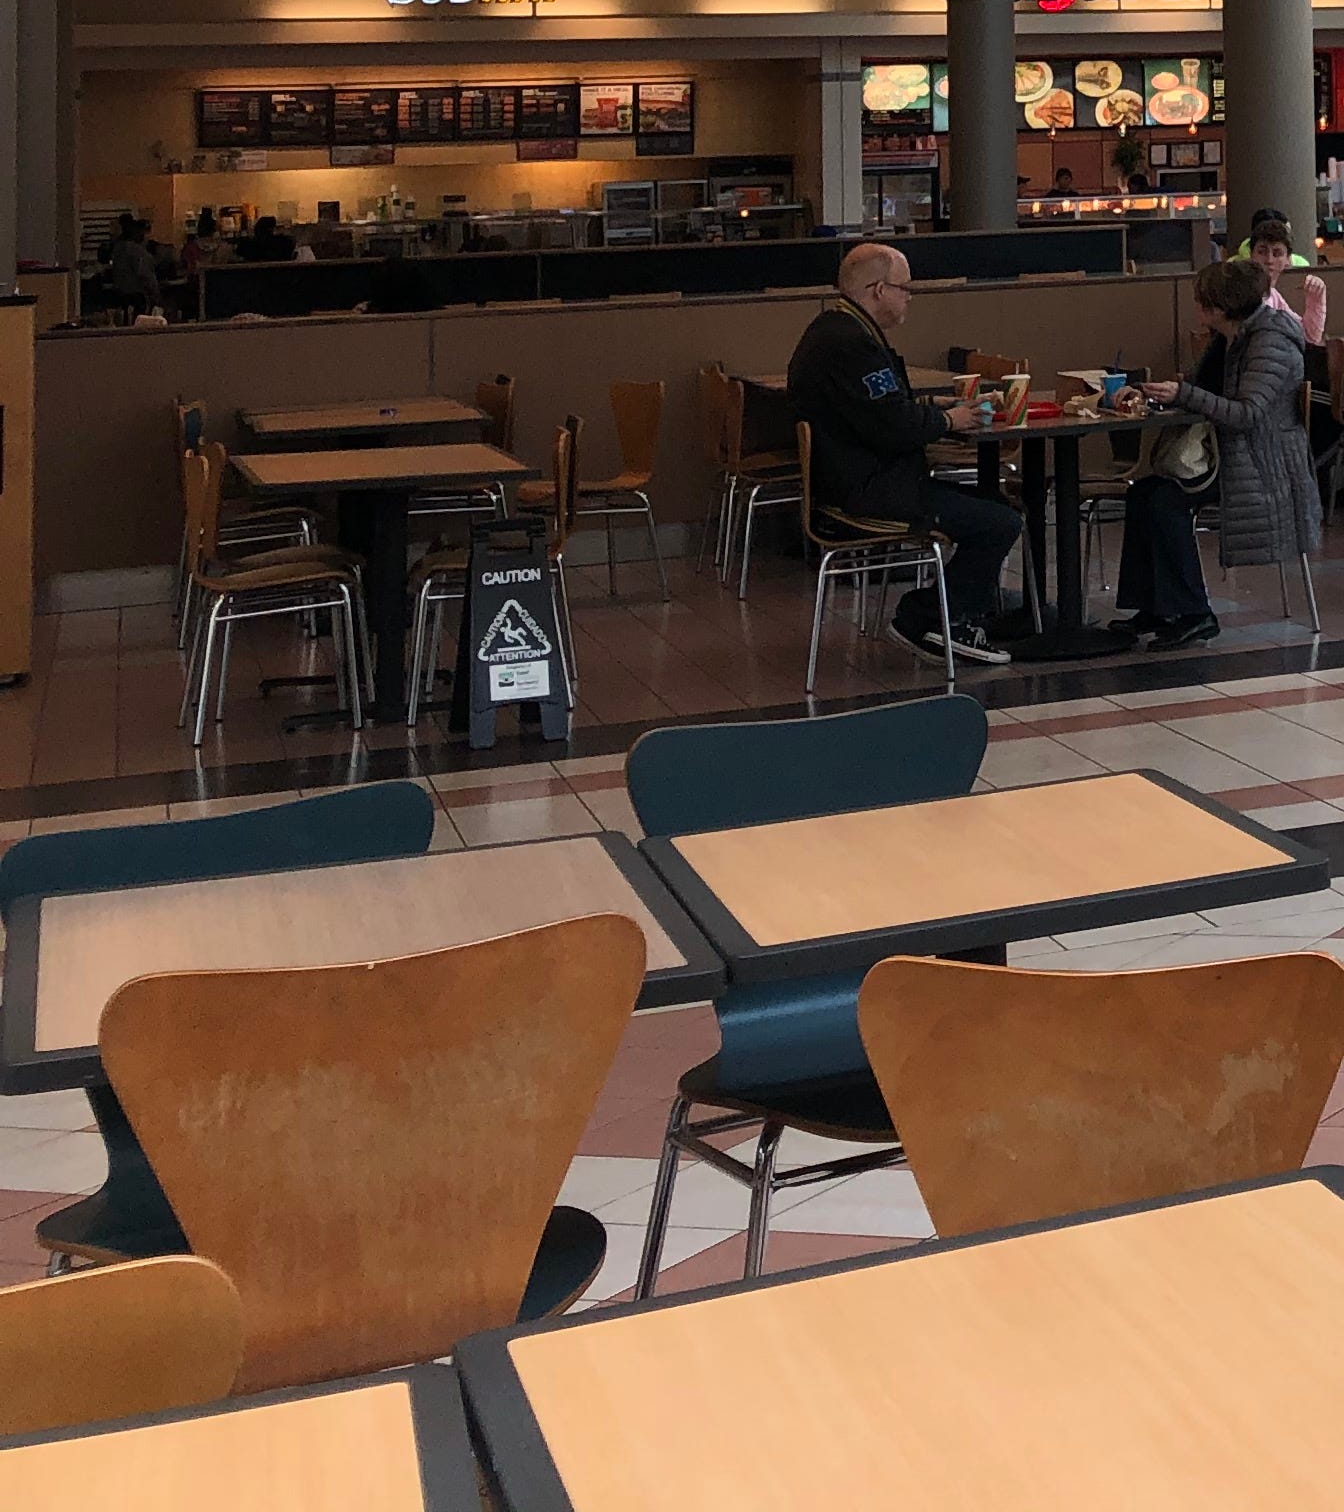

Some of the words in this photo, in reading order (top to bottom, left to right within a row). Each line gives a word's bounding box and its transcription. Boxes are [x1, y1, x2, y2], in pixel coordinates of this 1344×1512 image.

[481, 568, 541, 586] CAUTION
[480, 610, 507, 648] CAUTION
[520, 608, 548, 644] CUIDADO
[489, 648, 541, 662] ATTENTION
